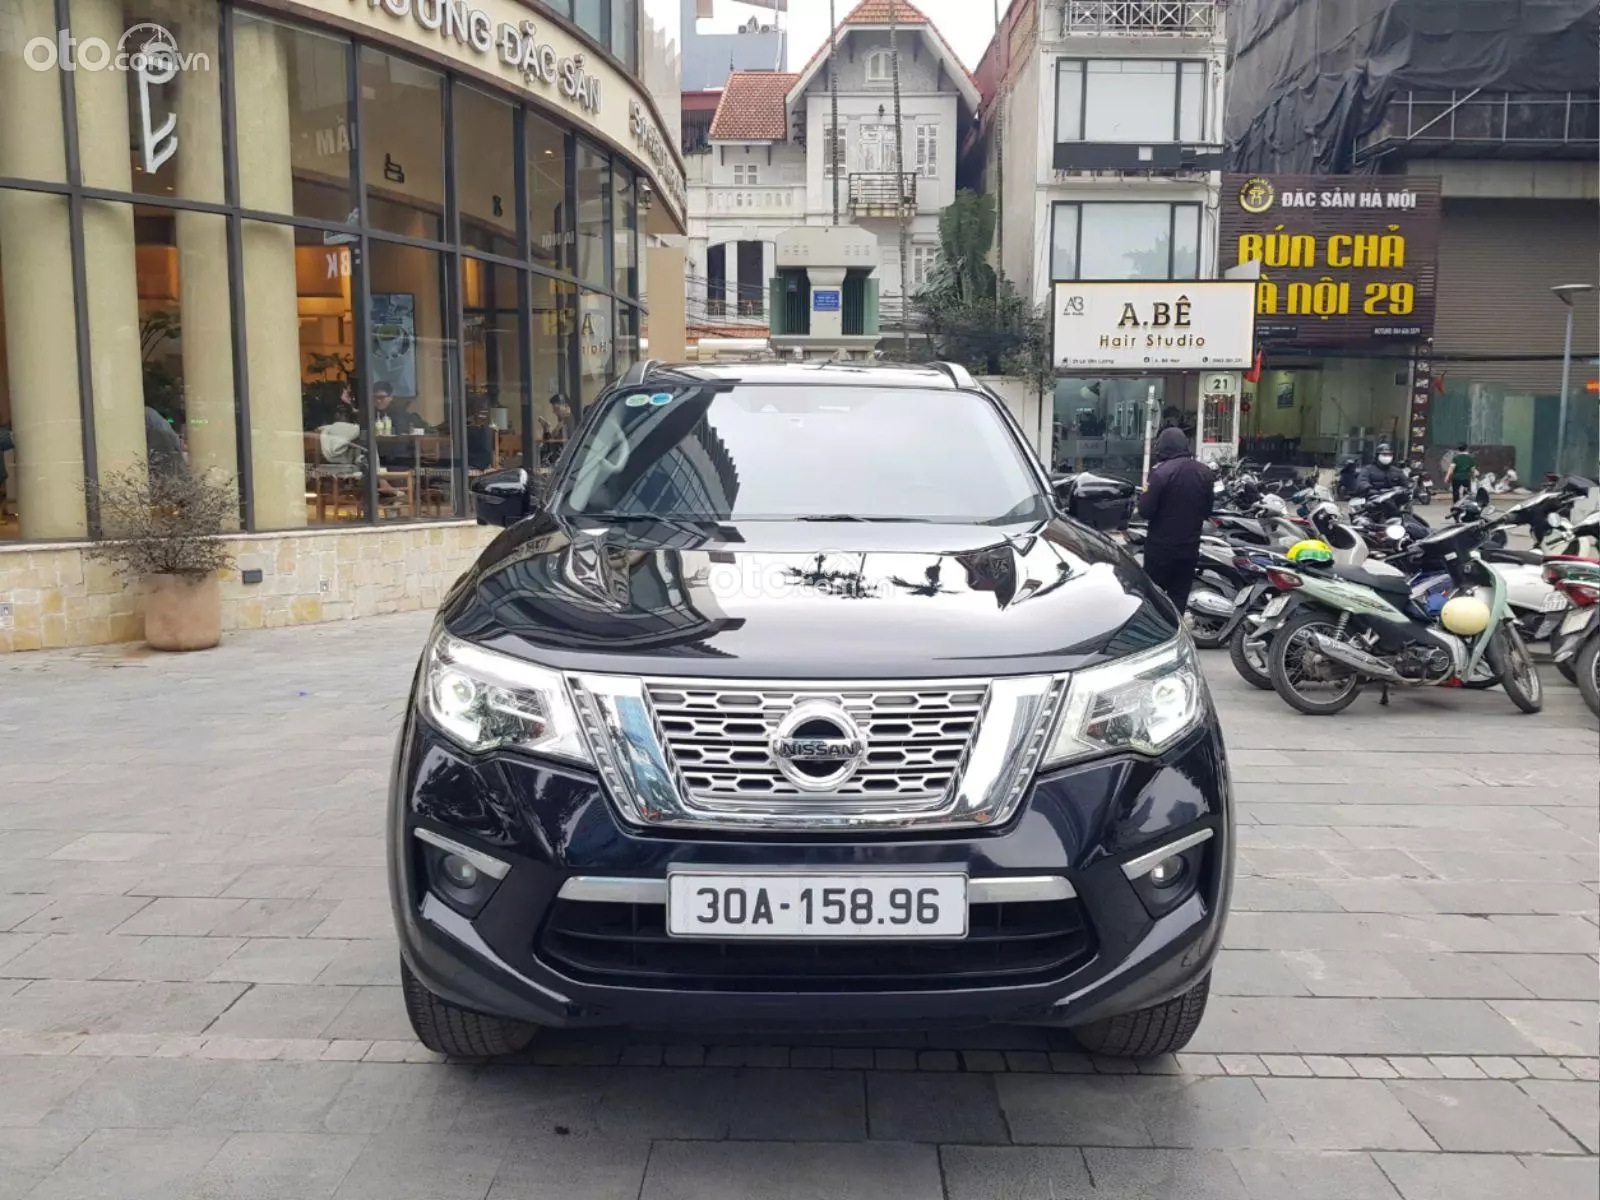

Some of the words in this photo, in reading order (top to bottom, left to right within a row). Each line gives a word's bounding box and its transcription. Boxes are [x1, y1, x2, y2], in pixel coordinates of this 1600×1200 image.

[496, 20, 557, 86] ĐẶC
[558, 53, 602, 115] SẢN
[1281, 188, 1317, 211] ĐẶC
[1320, 187, 1356, 208] SẢN
[1359, 188, 1384, 208] HÀ
[1387, 189, 1417, 211] NỘI
[1327, 224, 1405, 268] CHẢ
[1118, 294, 1192, 328] A.BÊ
[1256, 273, 1278, 315] À
[1363, 282, 1414, 316] 29
[1099, 334, 1137, 347] Hair
[1146, 334, 1206, 347] Studio
[1213, 378, 1228, 390] 21
[782, 743, 855, 756] NISSAN
[696, 887, 940, 925] 30A-158.96
